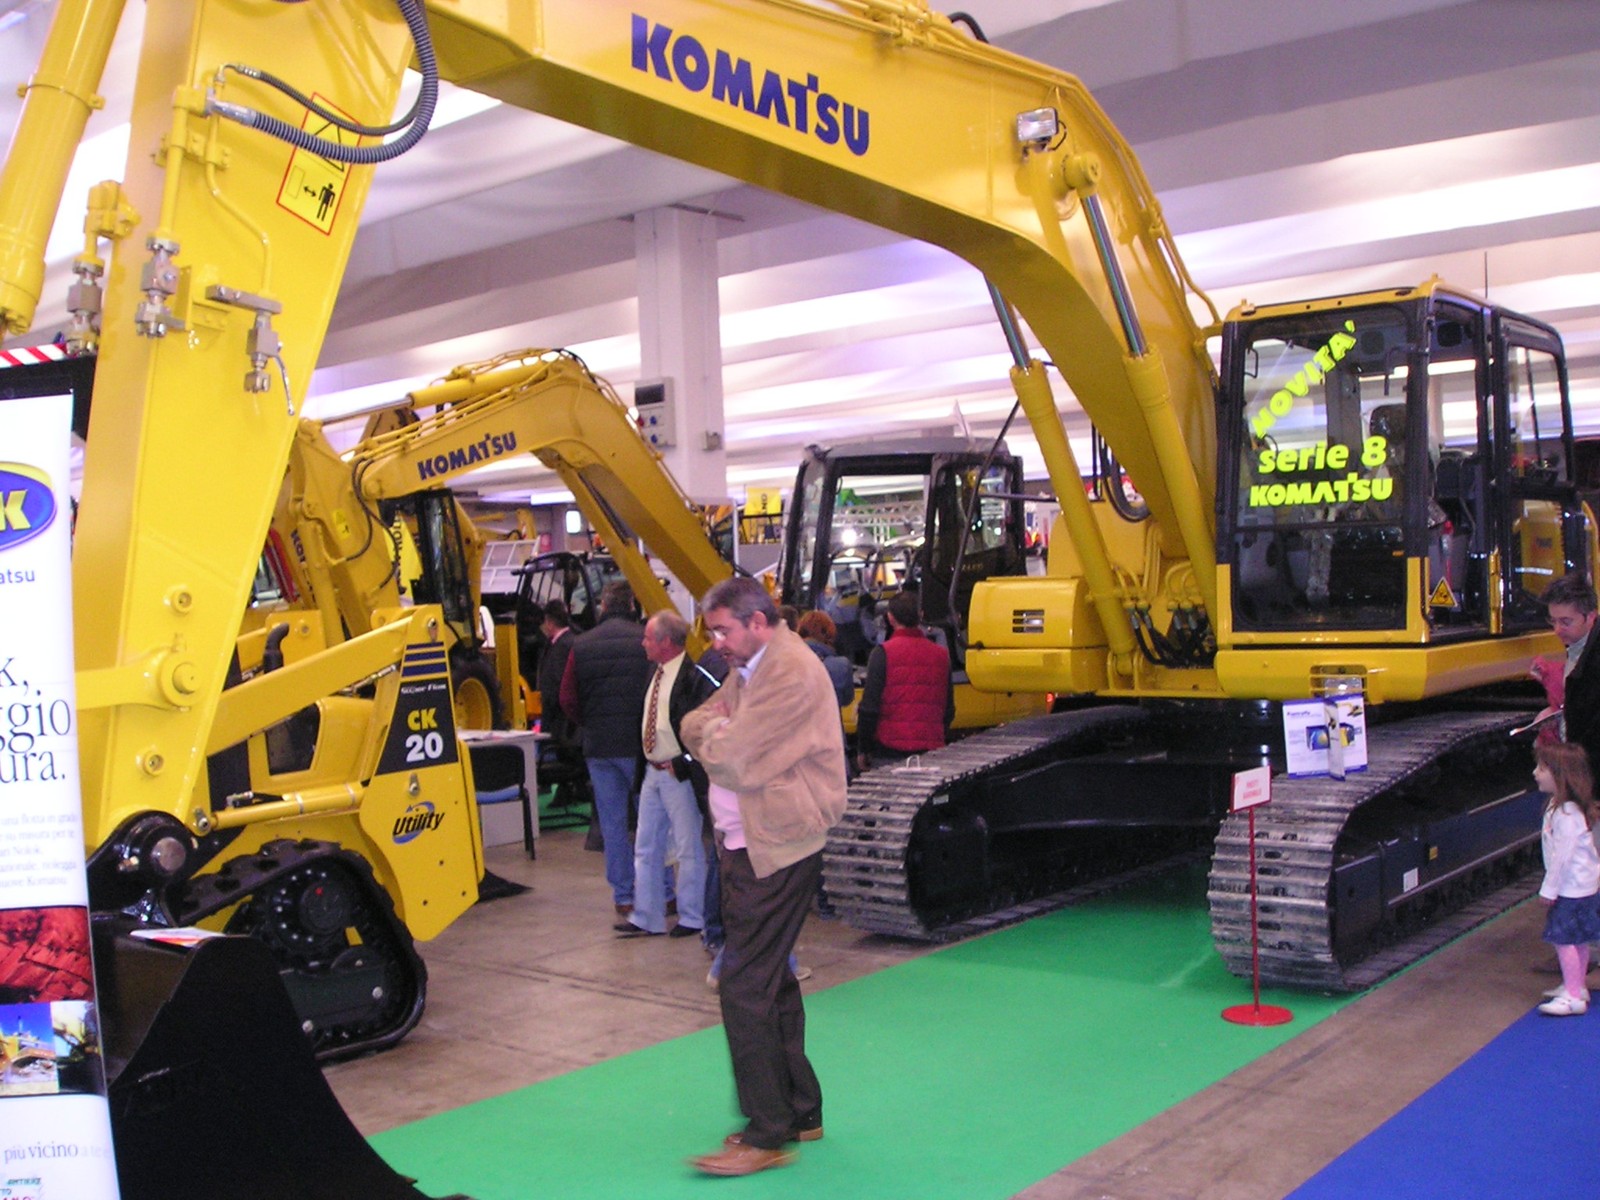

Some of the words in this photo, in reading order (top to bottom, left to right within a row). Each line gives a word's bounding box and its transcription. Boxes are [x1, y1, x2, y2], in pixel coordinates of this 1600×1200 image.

[631, 12, 869, 156] KOMATSU
[417, 431, 517, 480] KOMATSU
[1258, 440, 1349, 474] serie
[1361, 435, 1387, 467] 8
[1250, 472, 1393, 507] KOMATSU
[407, 707, 438, 731] CK
[405, 731, 443, 762] 20
[393, 812, 445, 836] Utility
[28, 1140, 79, 1158] vicino
